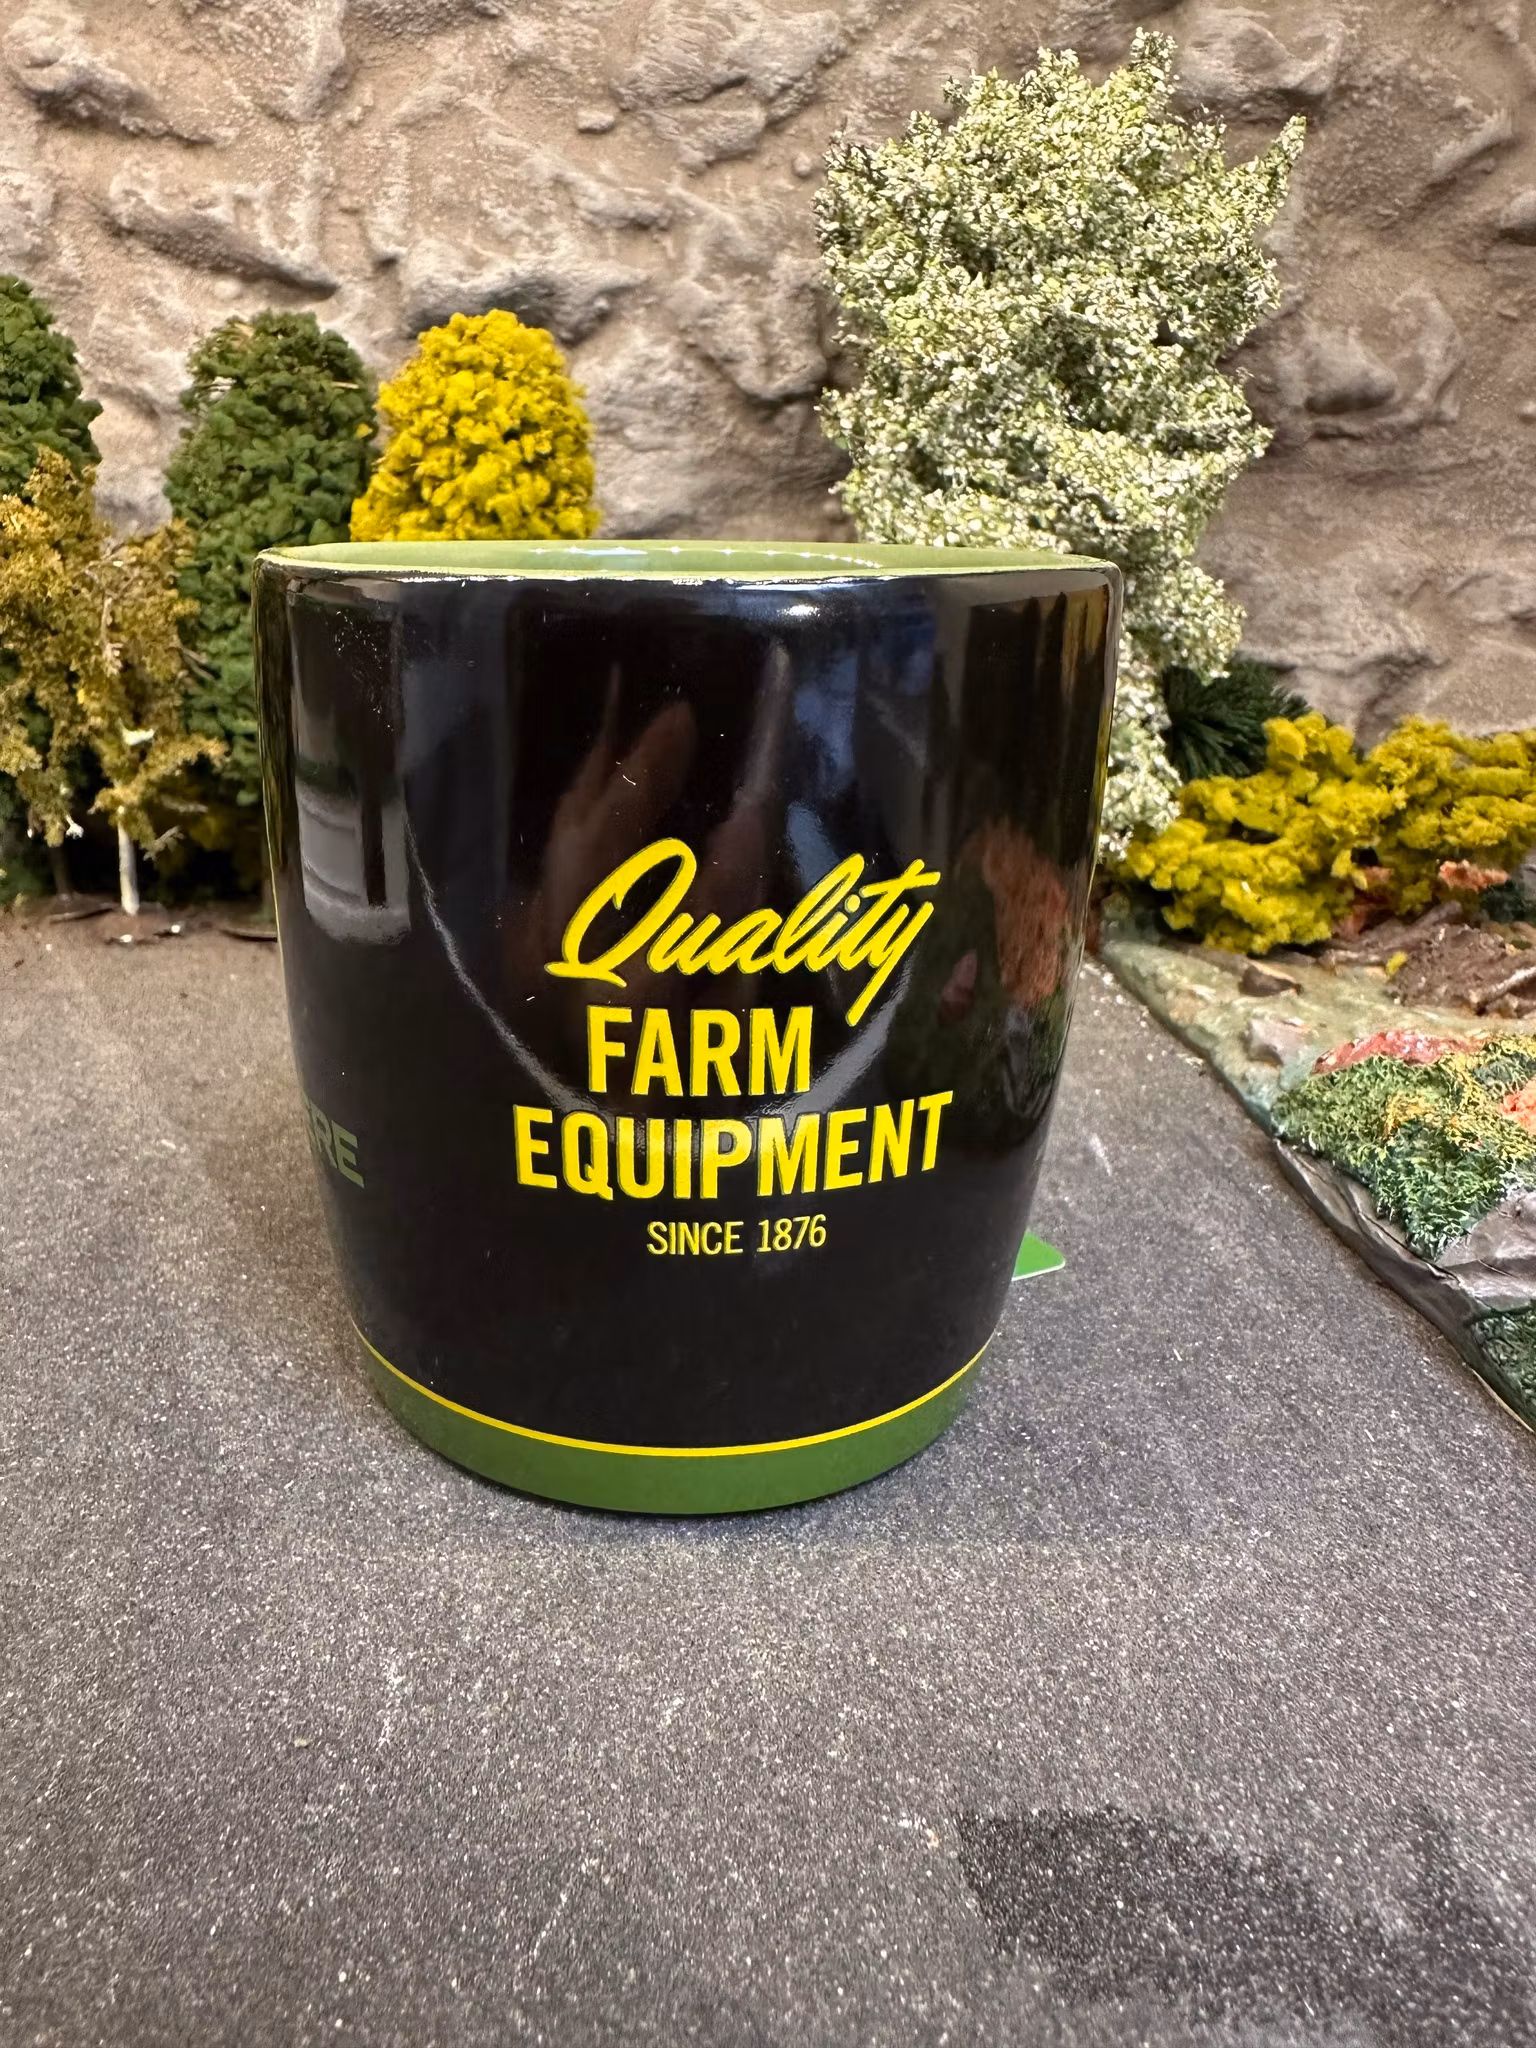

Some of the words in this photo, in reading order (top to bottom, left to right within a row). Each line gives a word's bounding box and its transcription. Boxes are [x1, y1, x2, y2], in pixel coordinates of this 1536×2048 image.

[544, 837, 941, 1027] Quality
[586, 1004, 814, 1097] FARM
[512, 1090, 954, 1201] EQUIPMENT
[646, 1220, 744, 1257] SINCE
[756, 1213, 828, 1253] 1876
